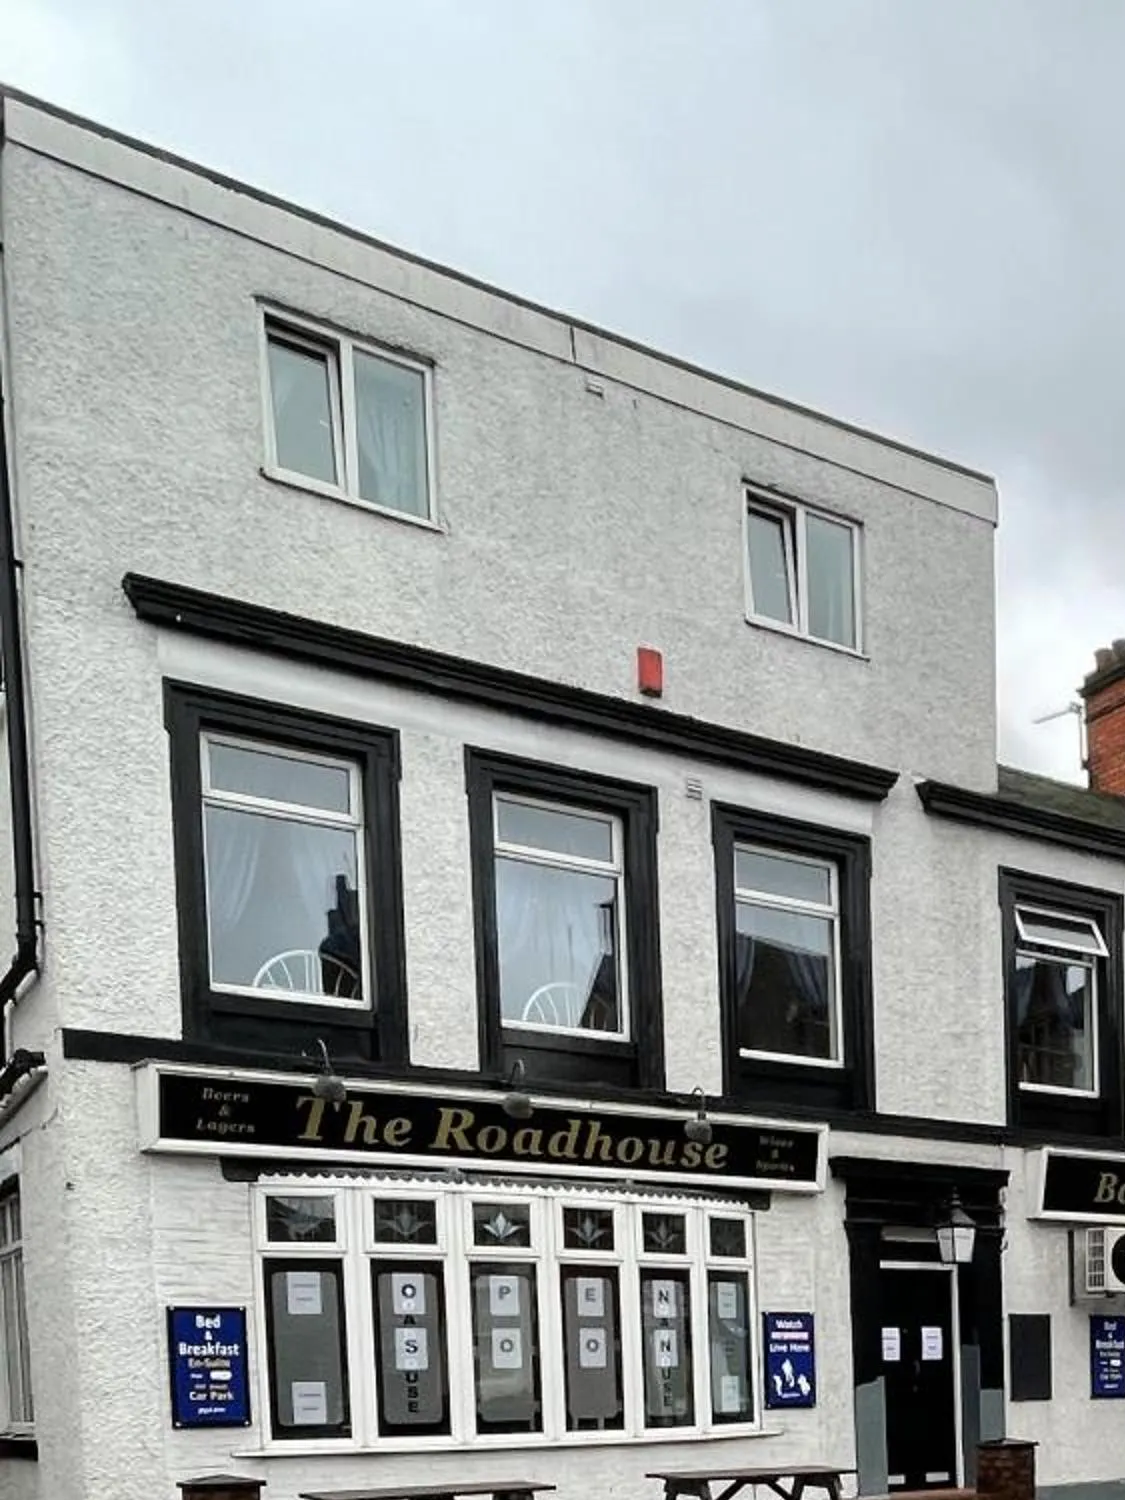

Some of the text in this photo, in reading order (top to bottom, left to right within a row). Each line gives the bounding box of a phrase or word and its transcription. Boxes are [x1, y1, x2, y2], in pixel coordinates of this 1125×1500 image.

[196, 1117, 255, 1135] Lagers
[296, 1096, 729, 1169] The Roadhouse
[195, 1315, 221, 1329] Bed
[178, 1341, 240, 1356] Breakfast
[189, 1391, 234, 1401] Car Park
